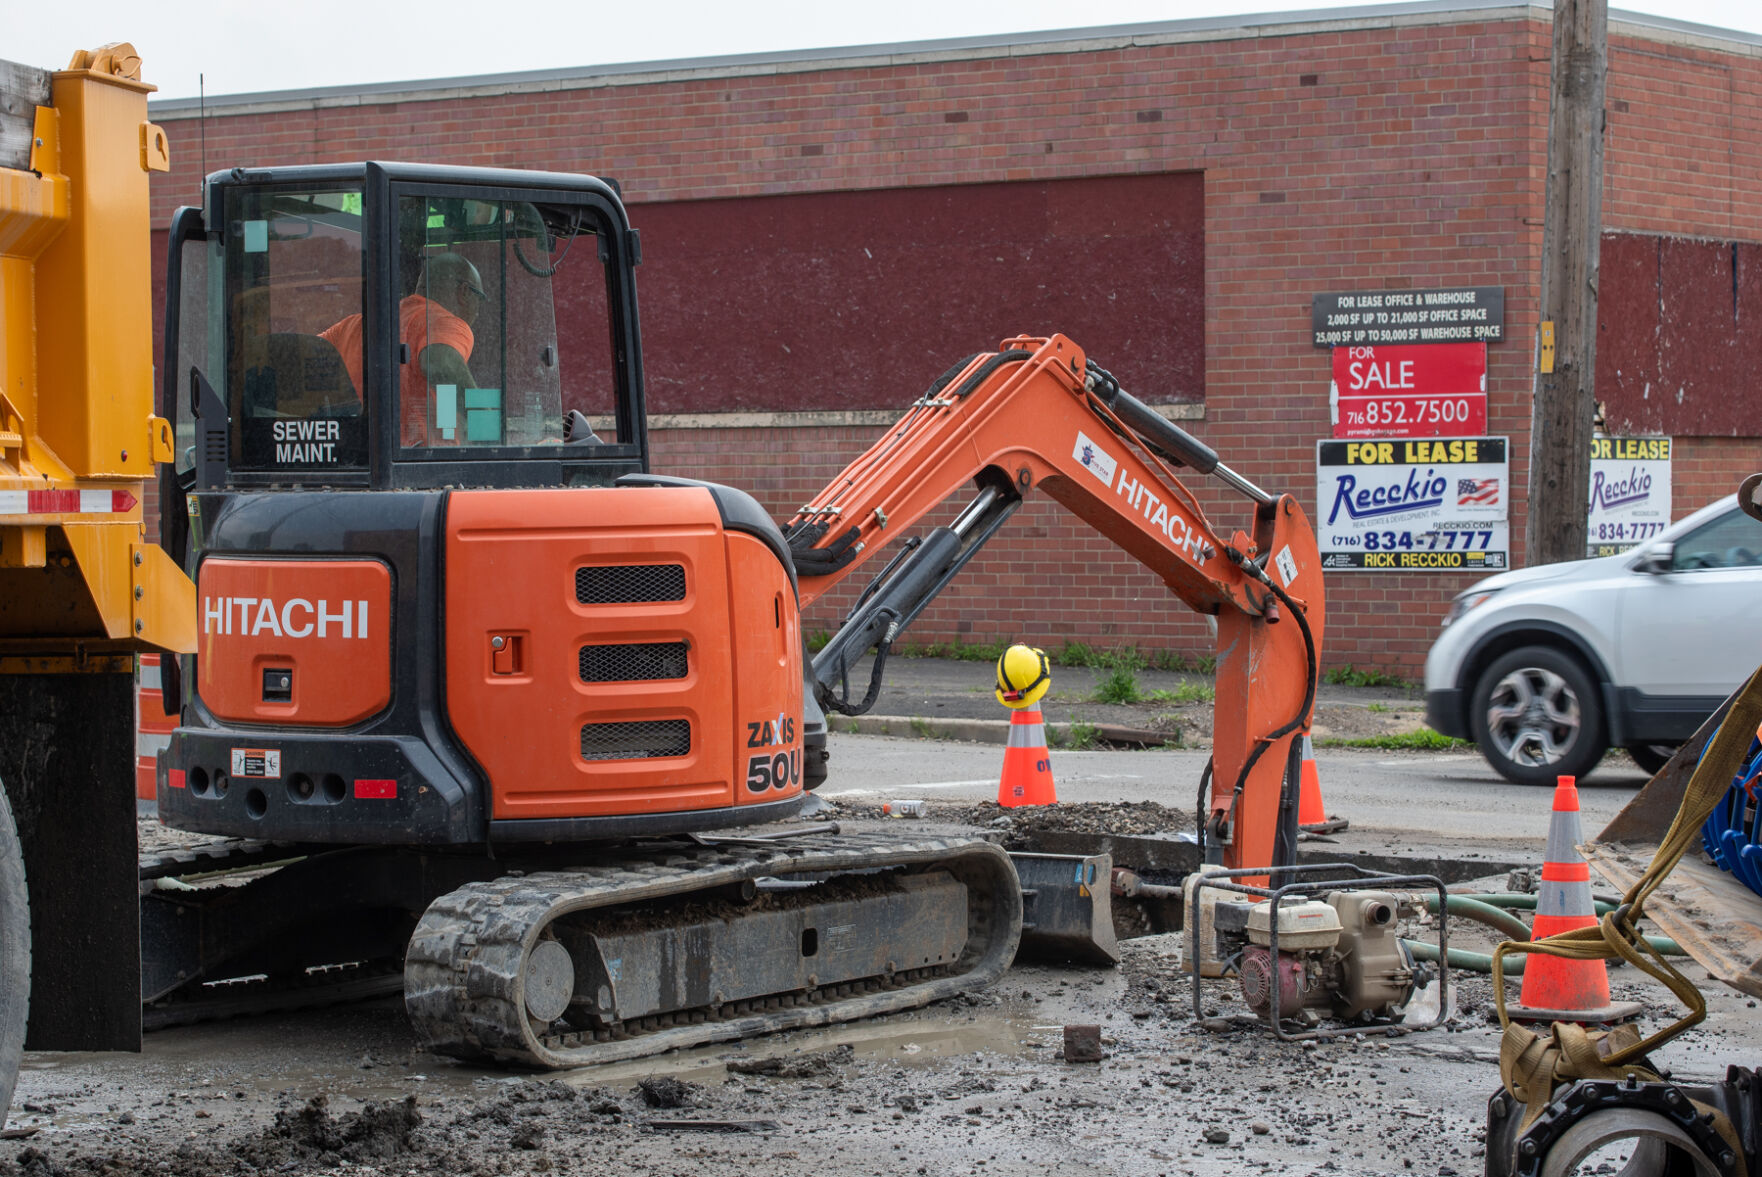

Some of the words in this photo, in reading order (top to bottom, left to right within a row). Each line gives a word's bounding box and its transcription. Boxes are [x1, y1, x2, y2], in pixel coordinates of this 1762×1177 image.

[1338, 296, 1355, 308] FOR
[1357, 295, 1382, 307] LEASE
[1385, 294, 1413, 306] OFFICE
[1416, 294, 1423, 305] &
[1424, 291, 1476, 304] WAREHOUSE
[1327, 313, 1349, 326] 2,000
[1350, 313, 1360, 324] SF
[1362, 312, 1375, 324] UP
[1377, 312, 1388, 324] TO
[1390, 311, 1418, 324] 21,000
[1419, 310, 1429, 322] SF
[1430, 309, 1458, 321] OFFICE
[1461, 308, 1487, 320] SPACE
[1315, 331, 1341, 344] 25,000
[1342, 330, 1352, 342] SF
[1354, 329, 1366, 341] UP
[1368, 329, 1380, 341] TO
[1380, 329, 1408, 342] 50,000
[1408, 328, 1419, 340] SF
[1420, 326, 1472, 339] WAREHOUSE
[1474, 325, 1500, 337] SPACE
[1349, 346, 1375, 359] FOR
[1349, 361, 1415, 390] SALE
[1347, 412, 1365, 424] 716
[1366, 399, 1469, 424] 852.7500
[273, 420, 340, 441] SEWER
[276, 443, 337, 463] MAINT.
[1347, 442, 1394, 464] FOR
[1405, 441, 1479, 464] LEASE
[1591, 439, 1612, 459] OR
[1616, 439, 1669, 459] LEASE
[1327, 468, 1448, 526] Recckio
[1589, 466, 1652, 515] Recckio
[1332, 535, 1361, 547] (716)
[1364, 531, 1493, 550] 834-7777
[1364, 552, 1396, 567] RICK
[1401, 552, 1462, 567] RECCKIO
[204, 596, 368, 639] HITACHI
[747, 712, 795, 748] ZAXIS
[746, 746, 801, 794] 50U
